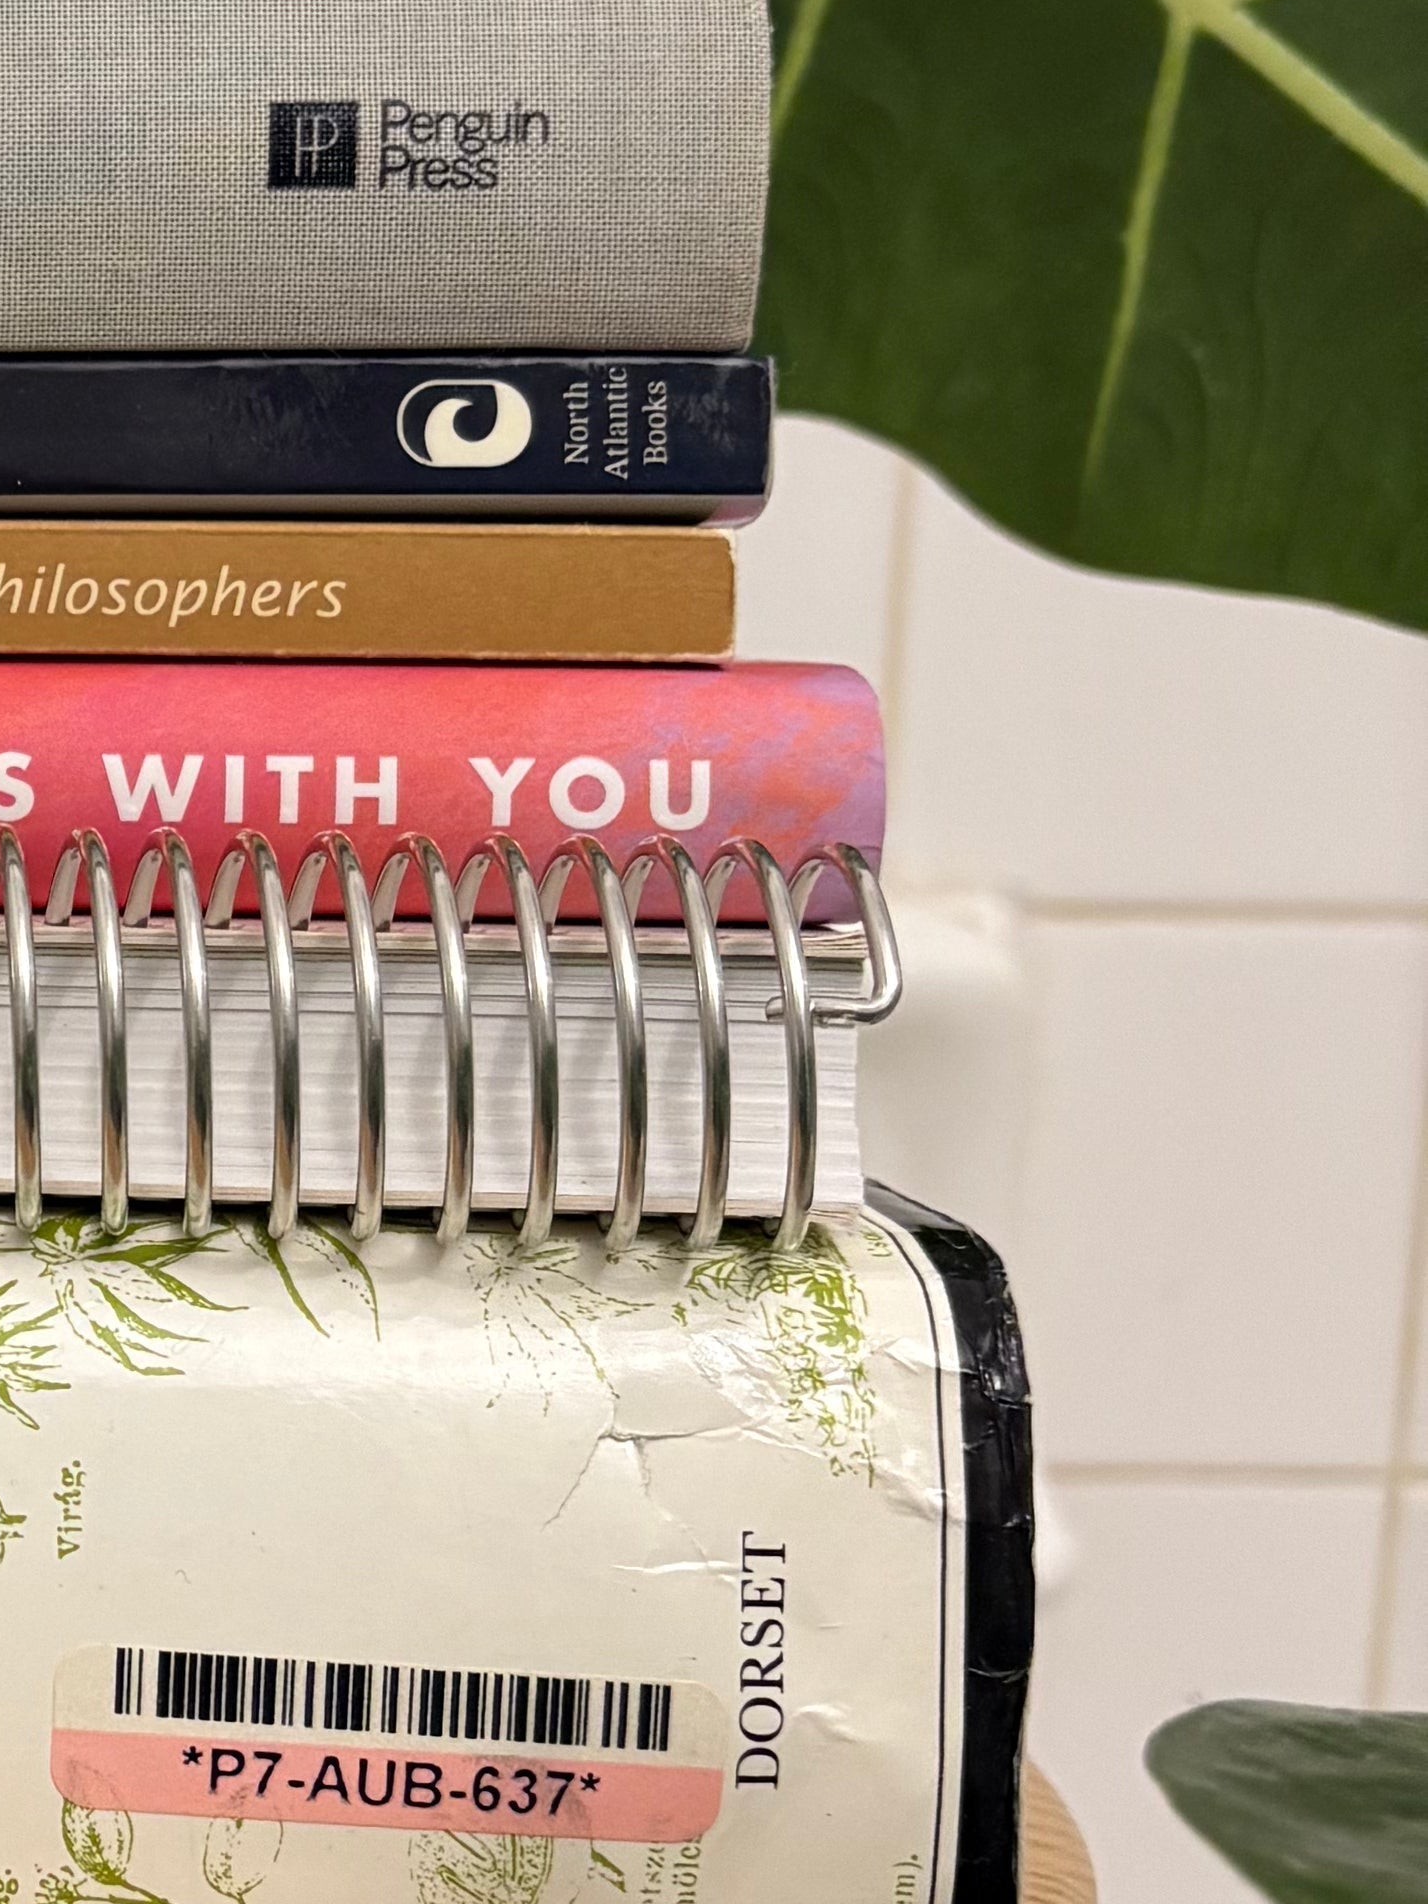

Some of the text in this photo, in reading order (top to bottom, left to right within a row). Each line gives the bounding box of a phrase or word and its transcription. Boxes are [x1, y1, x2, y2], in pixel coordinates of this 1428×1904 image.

[379, 145, 498, 191] Press
[381, 99, 550, 162] Penguin
[563, 382, 589, 464] North
[602, 367, 629, 479] Atlantic
[641, 381, 668, 464] Books
[102, 754, 398, 824] WITH
[469, 756, 711, 830] YOU
[57, 1459, 86, 1559] Virág.
[735, 1531, 786, 1789] DORSET
